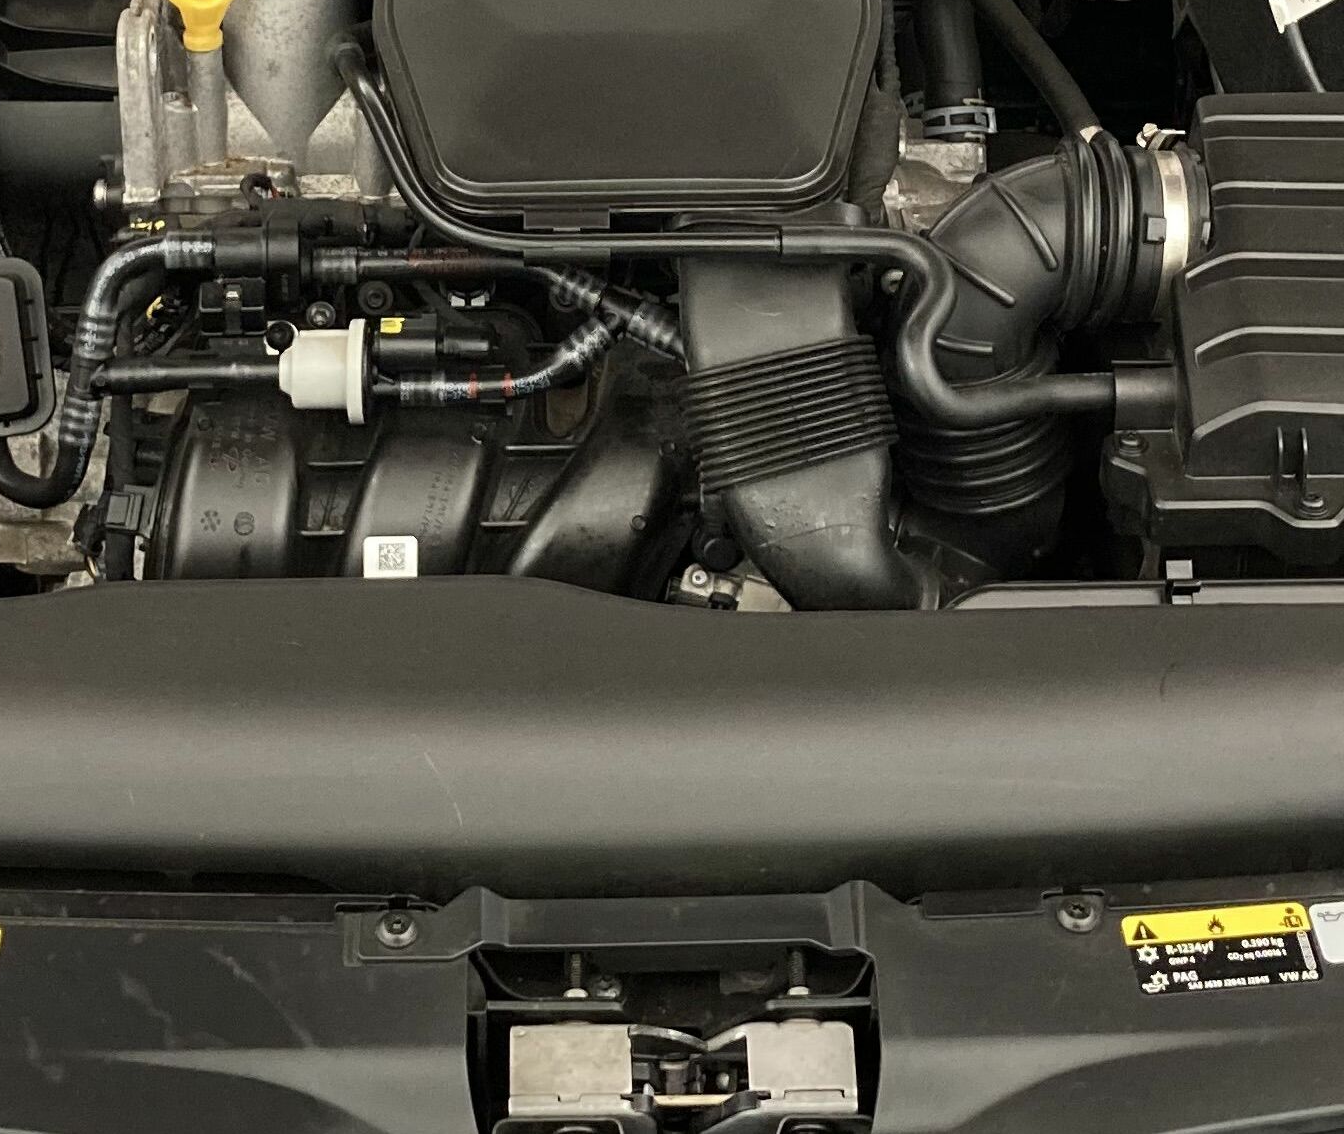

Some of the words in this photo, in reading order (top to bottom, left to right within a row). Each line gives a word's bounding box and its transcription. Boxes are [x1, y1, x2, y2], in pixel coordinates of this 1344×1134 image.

[1165, 940, 1214, 955] R-1234yf
[1271, 937, 1285, 948] kg
[1189, 956, 1196, 964] 4
[1172, 970, 1199, 983] PAG
[1279, 971, 1299, 982] VW
[1301, 969, 1319, 981] AG
